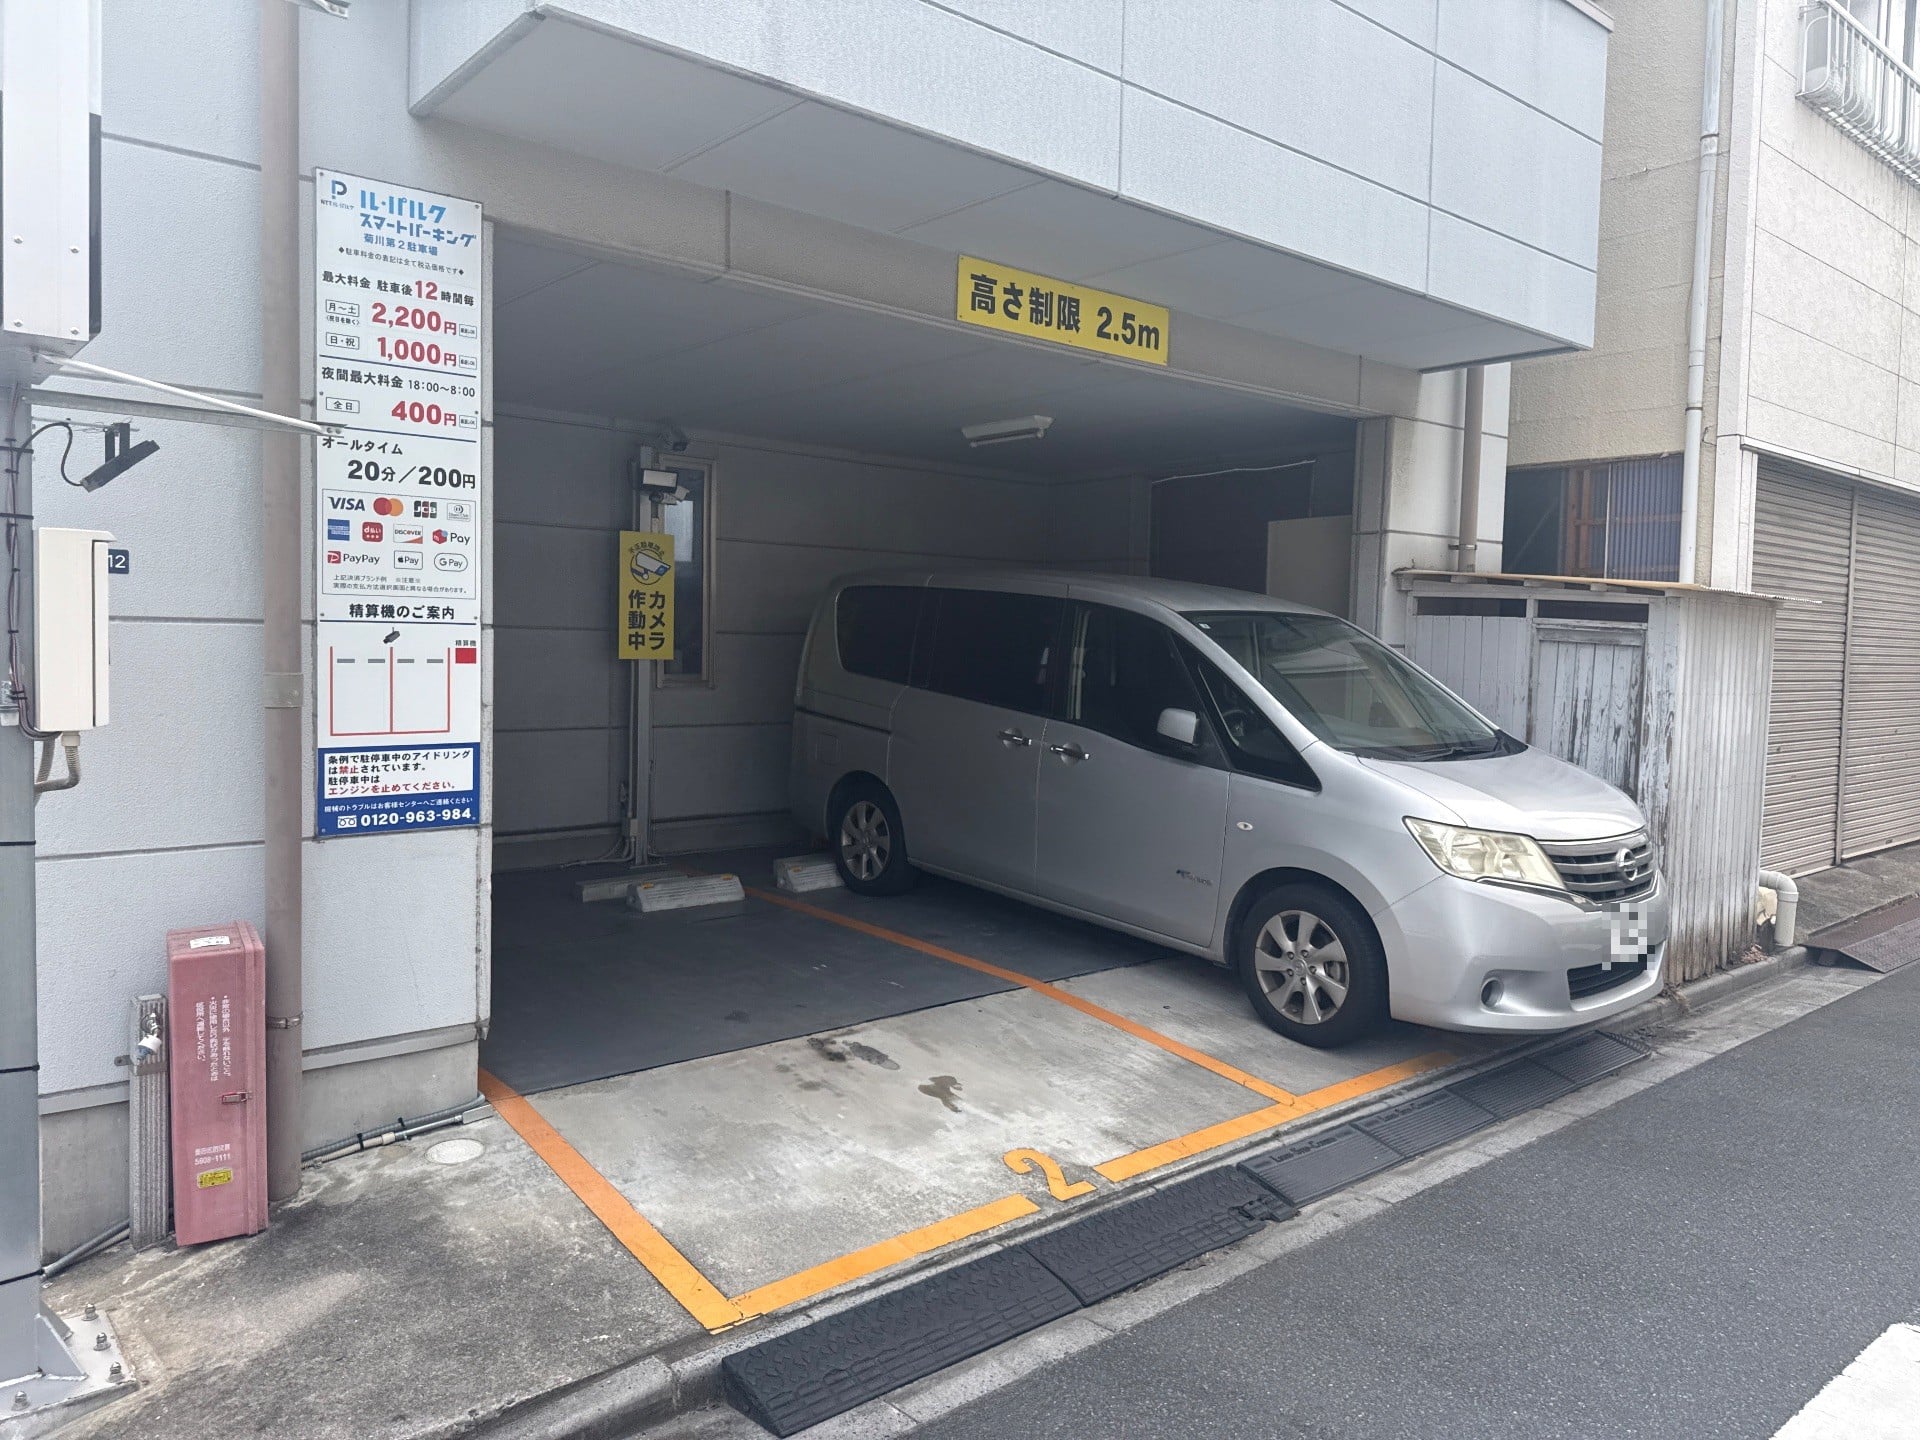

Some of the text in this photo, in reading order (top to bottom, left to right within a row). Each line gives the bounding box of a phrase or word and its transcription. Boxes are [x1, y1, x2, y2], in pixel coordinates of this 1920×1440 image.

[360, 190, 446, 223] ル・パルク
[360, 213, 477, 247] スマートパーキング
[364, 233, 438, 256] 菊川第2駐車場
[322, 271, 475, 307] 最大料金 駐車後12時間毎
[372, 302, 457, 336] 2,200円
[970, 273, 1160, 350] 高さ制限 2.5m
[377, 337, 457, 367] 1,000円
[321, 367, 403, 389] 夜間最大料金
[333, 401, 353, 410] 全日
[391, 400, 457, 427] 400円
[322, 437, 403, 455] オールタイム
[327, 497, 437, 518] VISA JCB
[450, 531, 471, 545] Pay
[343, 553, 380, 564] PayPay
[404, 556, 419, 566] Pay
[349, 604, 455, 620] 精算機のご案内
[628, 589, 646, 651] 作動中
[649, 591, 666, 650] カメラ
[328, 750, 471, 765] 条例で駐停車中のアイドリング
[328, 762, 426, 775] は禁止されています。
[328, 775, 380, 786] 駐停車中は
[328, 782, 456, 796] エンジンを止めてください。
[361, 807, 471, 826] 0120-963-984
[1003, 1148, 1097, 1201] 2
